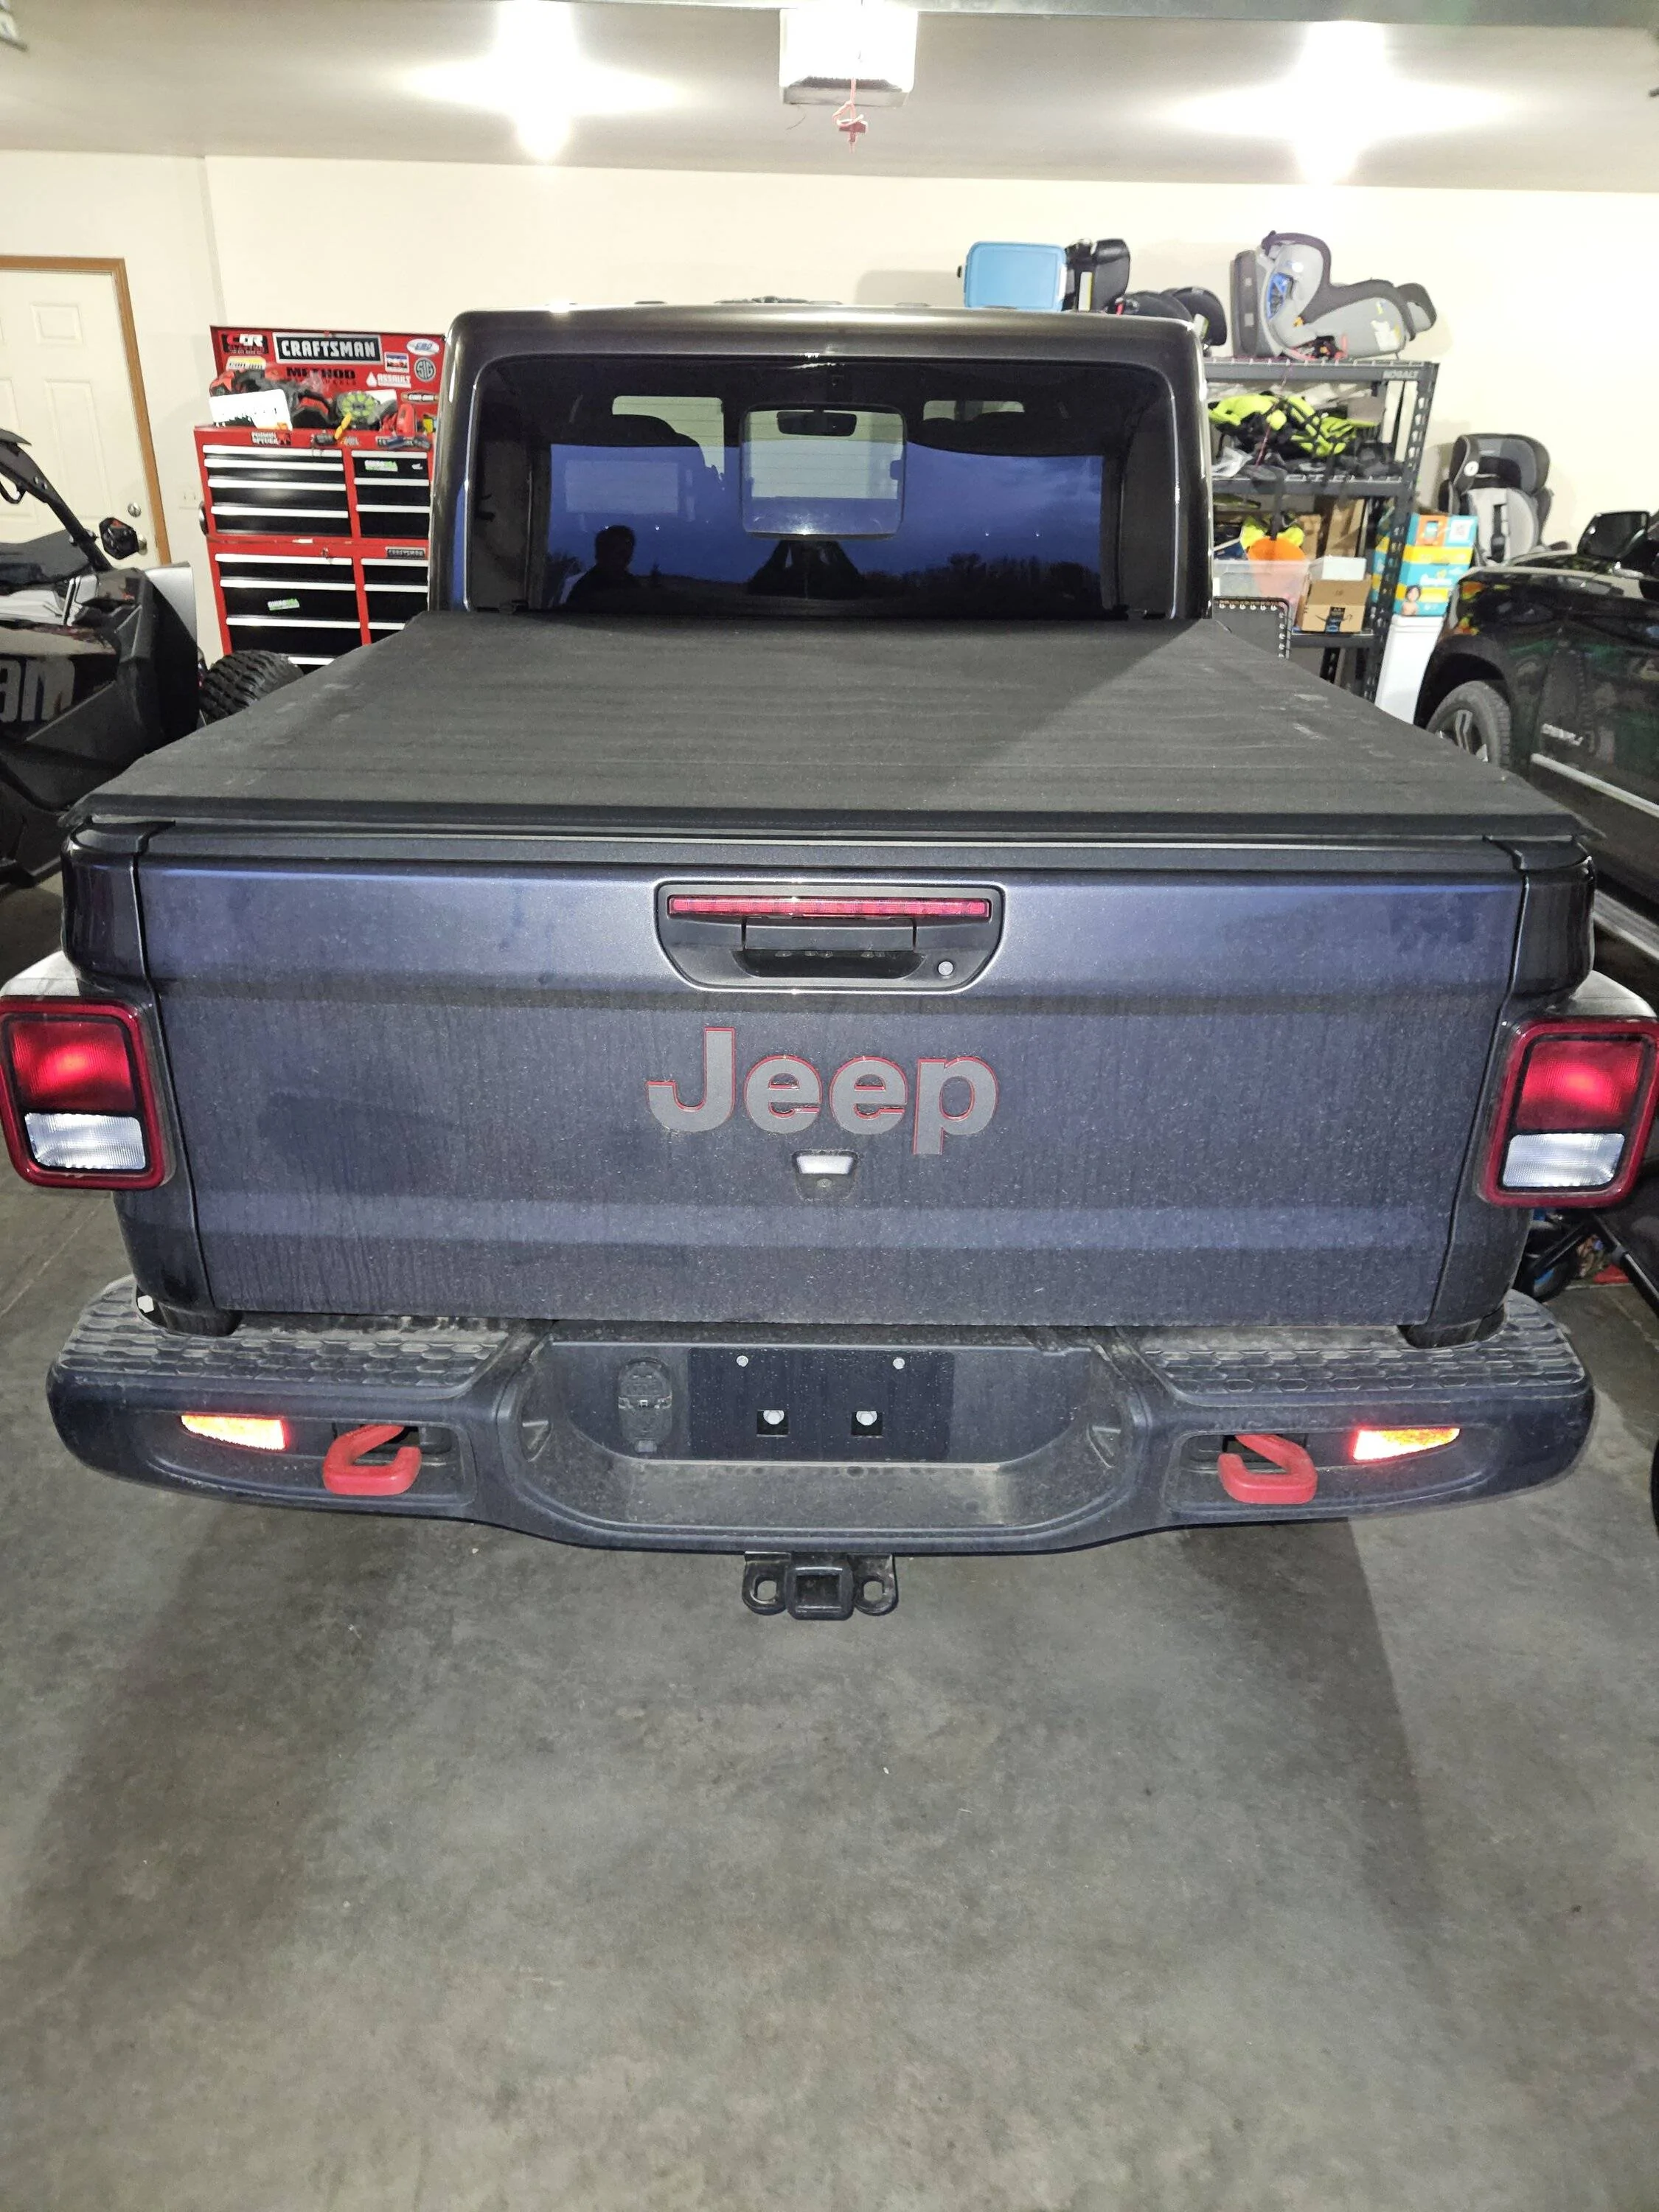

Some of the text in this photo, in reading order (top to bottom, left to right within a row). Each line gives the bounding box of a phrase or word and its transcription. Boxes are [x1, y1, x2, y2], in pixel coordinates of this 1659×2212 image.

[281, 340, 375, 358] CRAFTSMAN
[416, 359, 434, 380] SIG
[646, 1026, 999, 1155] Jeep
